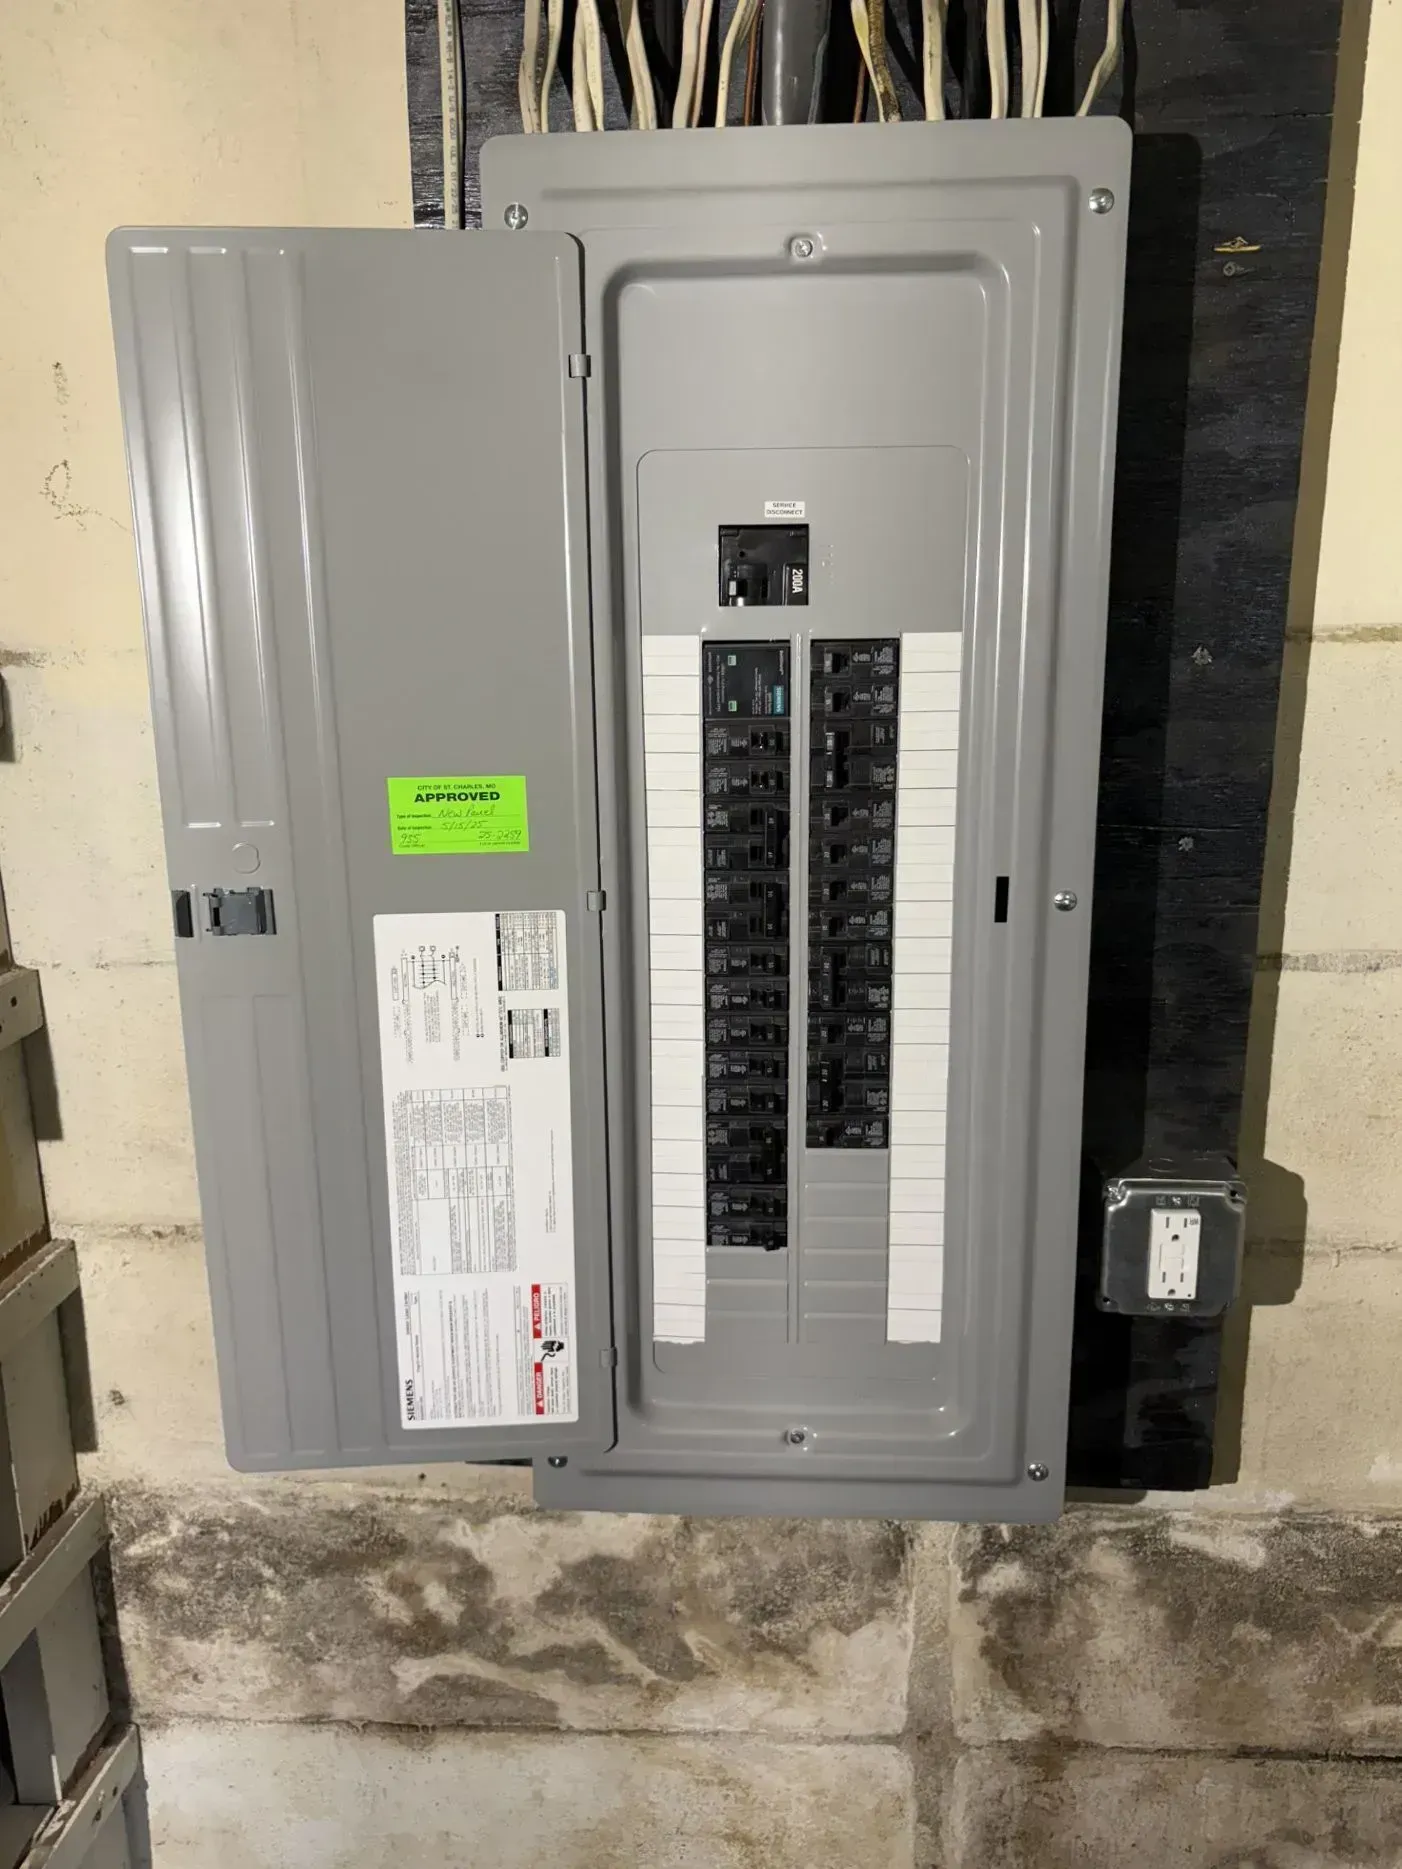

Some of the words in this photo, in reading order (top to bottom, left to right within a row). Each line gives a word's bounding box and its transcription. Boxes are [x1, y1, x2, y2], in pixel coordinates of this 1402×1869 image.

[792, 568, 804, 594] 200A
[413, 791, 501, 803] APPROVED
[407, 1379, 415, 1421] SIEMENS
